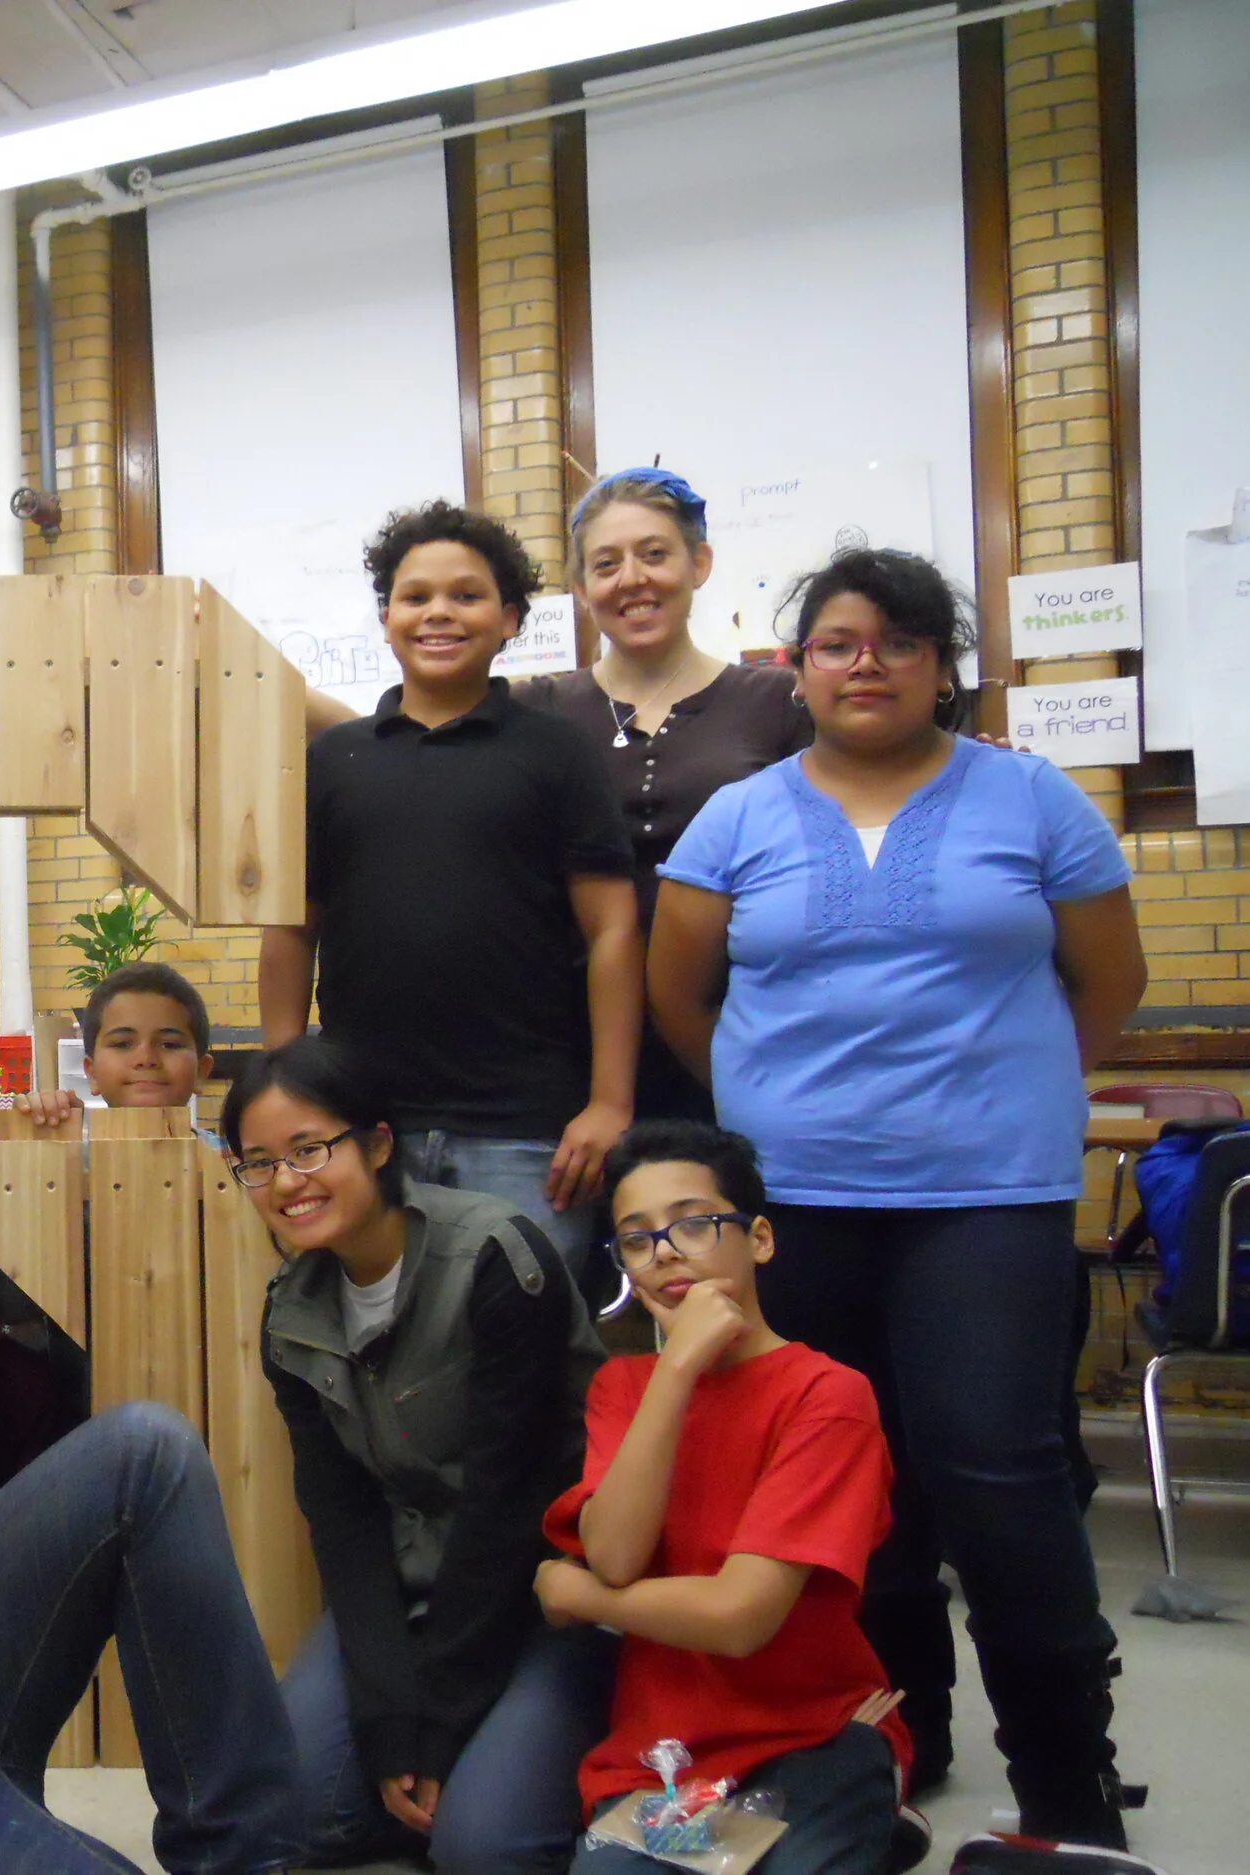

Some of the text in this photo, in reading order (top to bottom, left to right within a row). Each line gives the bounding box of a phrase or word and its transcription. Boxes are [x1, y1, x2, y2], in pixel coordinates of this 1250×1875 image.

[1034, 587, 1114, 608] You are
[532, 609, 564, 627] you
[533, 631, 561, 647] this
[1033, 695, 1112, 712] You are
[1017, 723, 1035, 737] a
